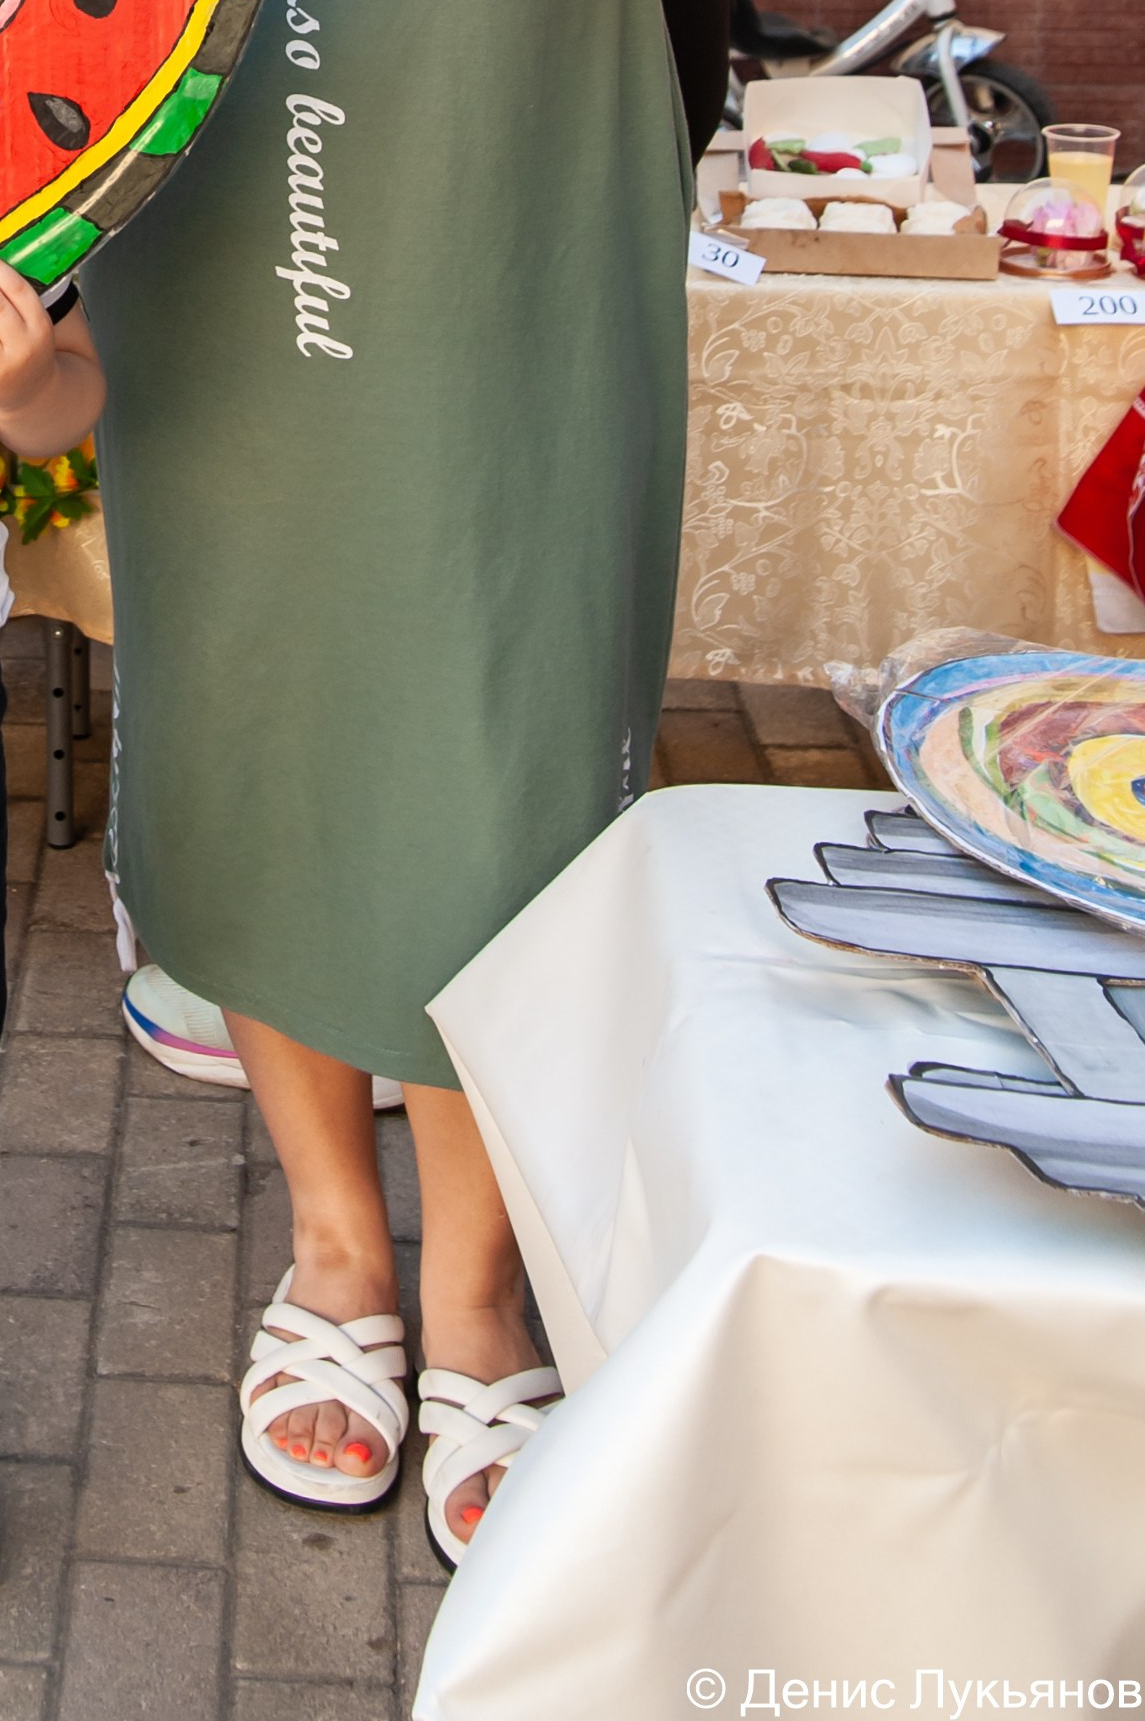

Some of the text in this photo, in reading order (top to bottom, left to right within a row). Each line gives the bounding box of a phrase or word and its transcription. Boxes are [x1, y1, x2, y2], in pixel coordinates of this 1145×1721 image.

[275, 93, 353, 361] beautiful
[701, 242, 739, 269] 30
[1078, 295, 1137, 316] 200
